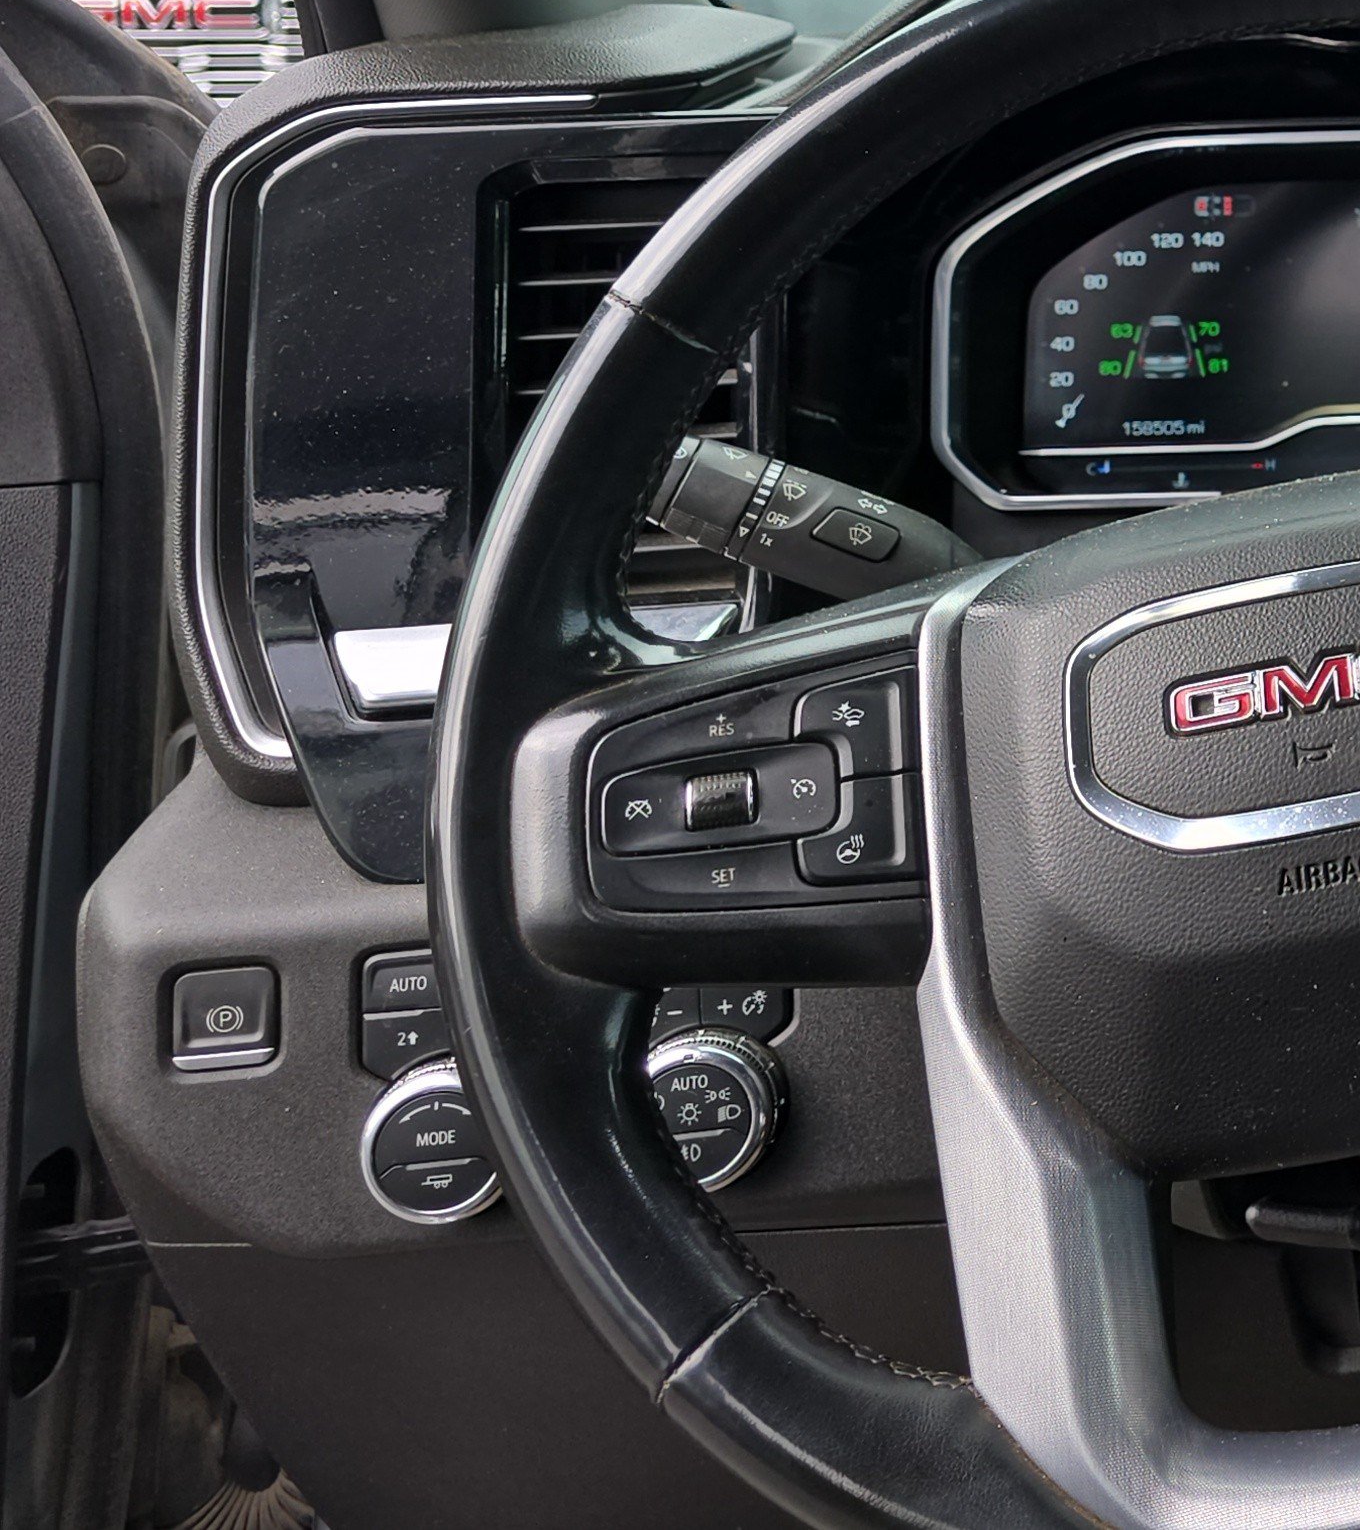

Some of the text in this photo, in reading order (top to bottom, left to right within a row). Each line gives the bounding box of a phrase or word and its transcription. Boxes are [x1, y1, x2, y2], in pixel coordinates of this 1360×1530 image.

[1151, 233, 1184, 249] 120
[1191, 232, 1225, 249] 140
[1113, 251, 1147, 267] 100
[1083, 274, 1108, 290] 80
[1198, 322, 1220, 337] 70
[1050, 336, 1075, 352] 40
[1049, 372, 1075, 388] 20
[1187, 419, 1206, 435] mi
[765, 510, 790, 527] OFF
[760, 533, 774, 548] 1x
[709, 723, 735, 737] RES
[711, 868, 736, 883] SET
[390, 975, 428, 993] AUTO
[397, 1031, 408, 1047] 2
[670, 1073, 708, 1092] AUTO
[416, 1128, 456, 1146] MODE
